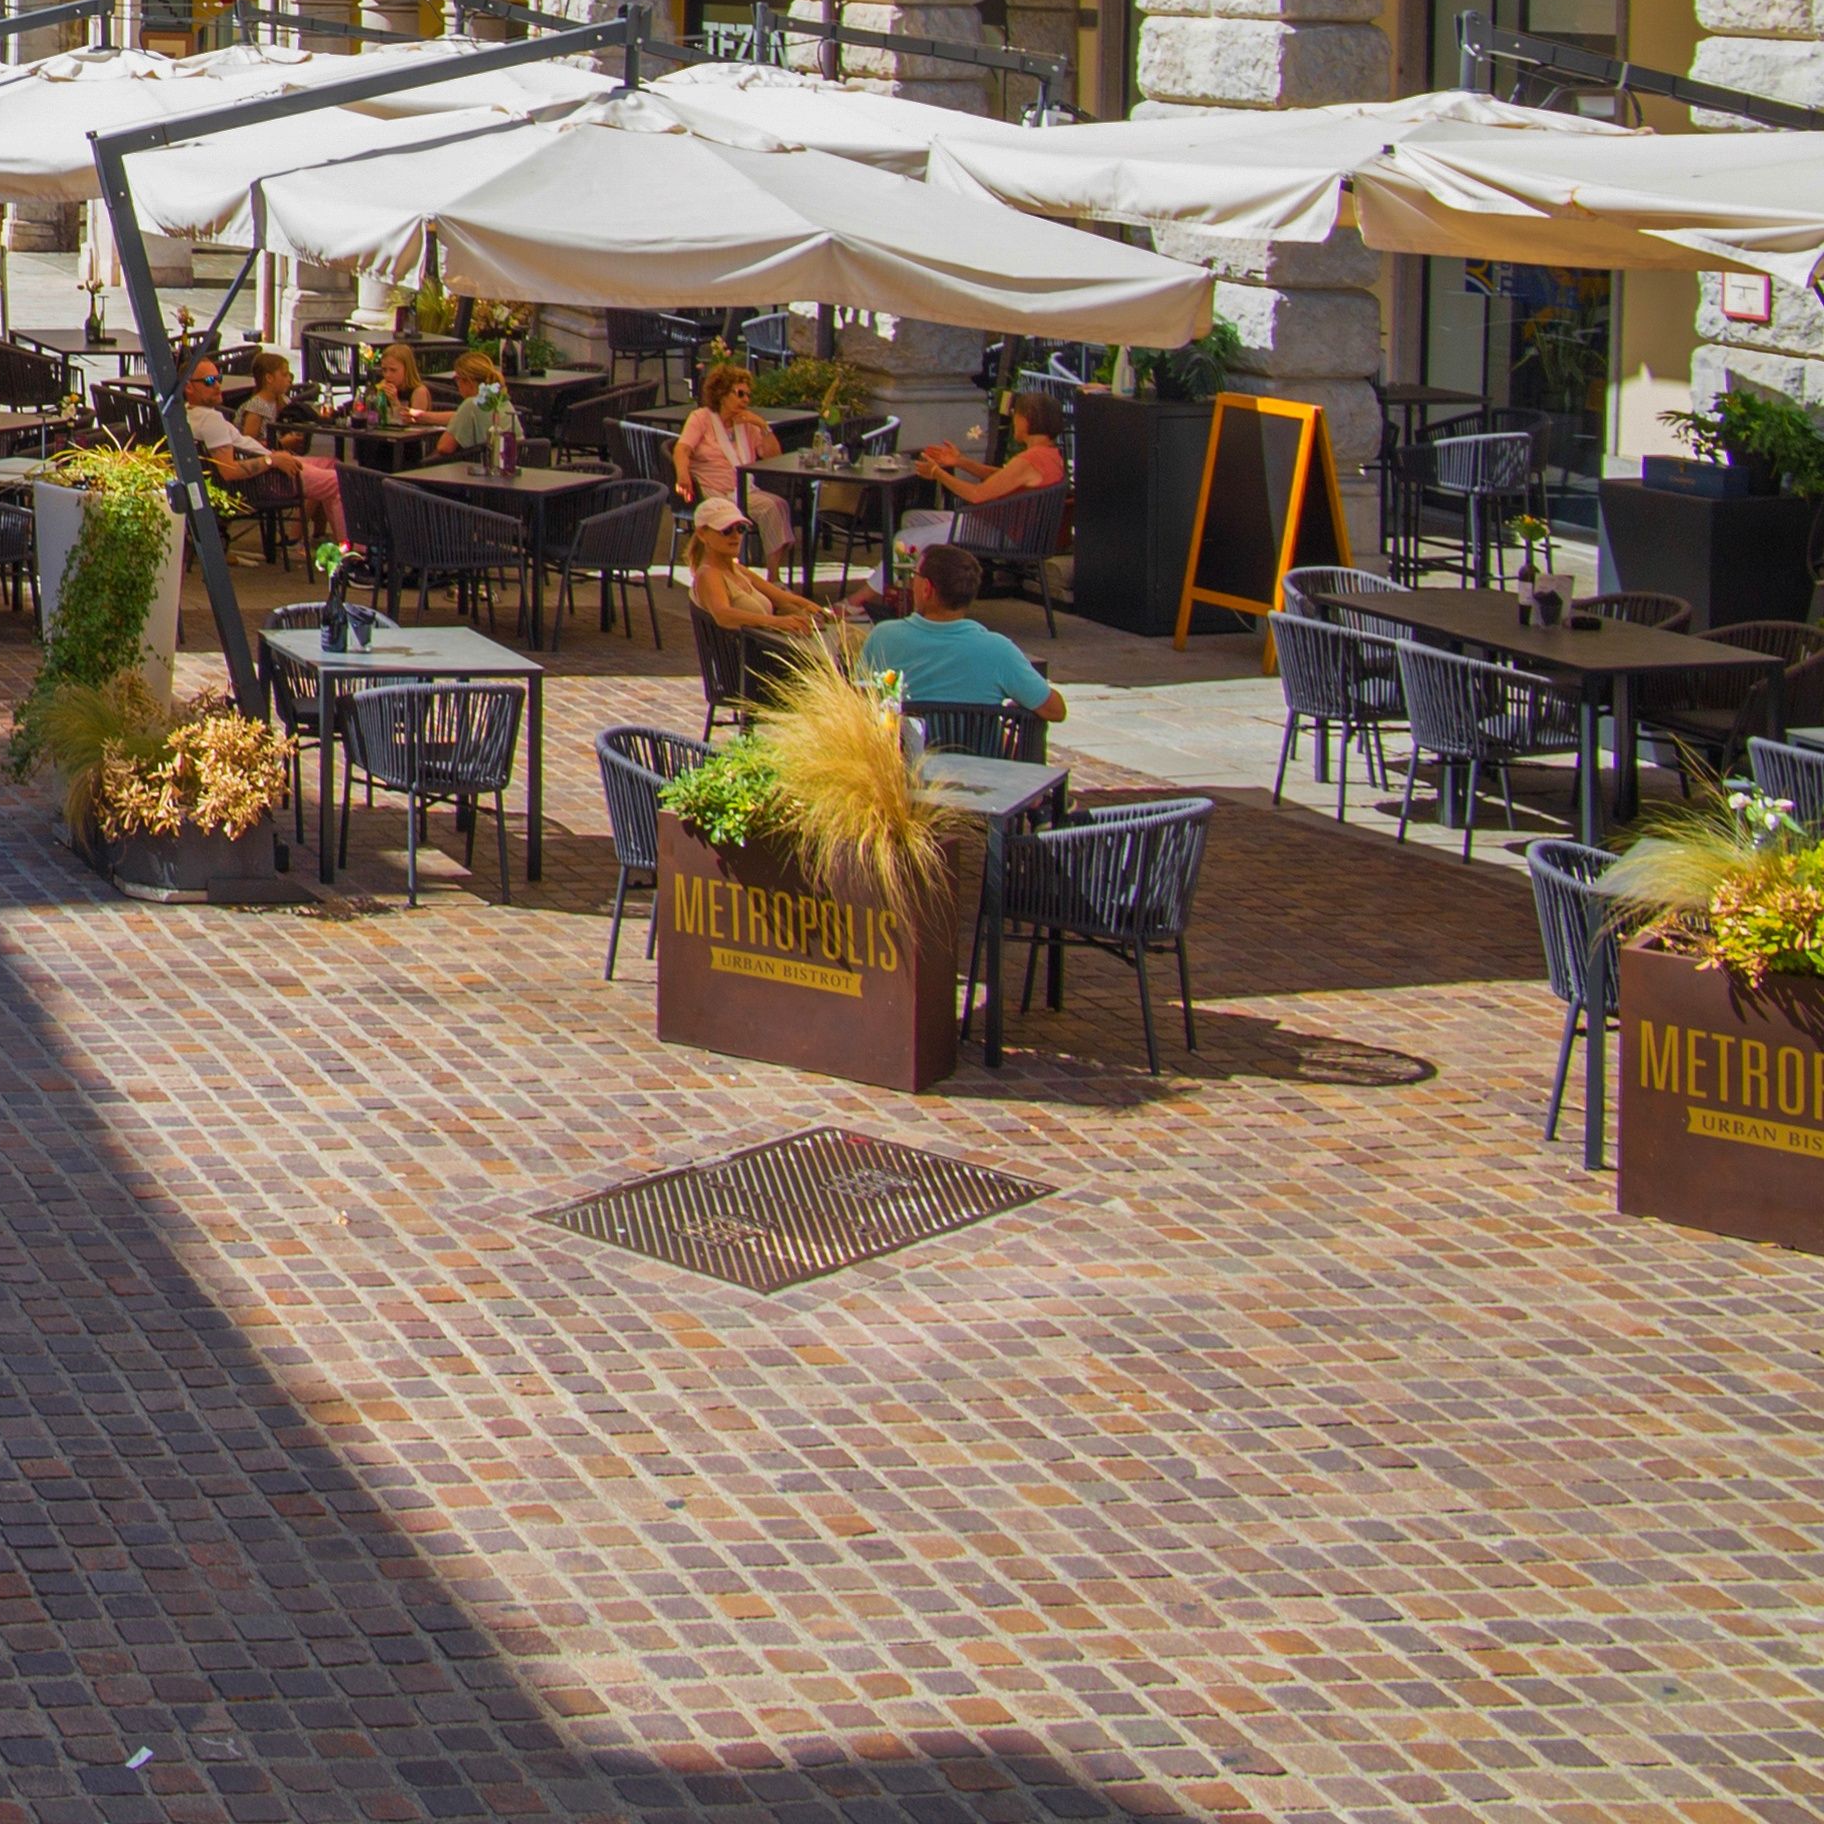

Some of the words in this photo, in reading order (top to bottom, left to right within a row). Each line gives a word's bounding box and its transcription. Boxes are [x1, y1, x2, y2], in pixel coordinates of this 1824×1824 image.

[675, 873, 897, 972] METROPOLIS
[720, 953, 775, 975] URBAN
[783, 967, 852, 989] BISTROT
[1702, 1115, 1777, 1142] URBAN
